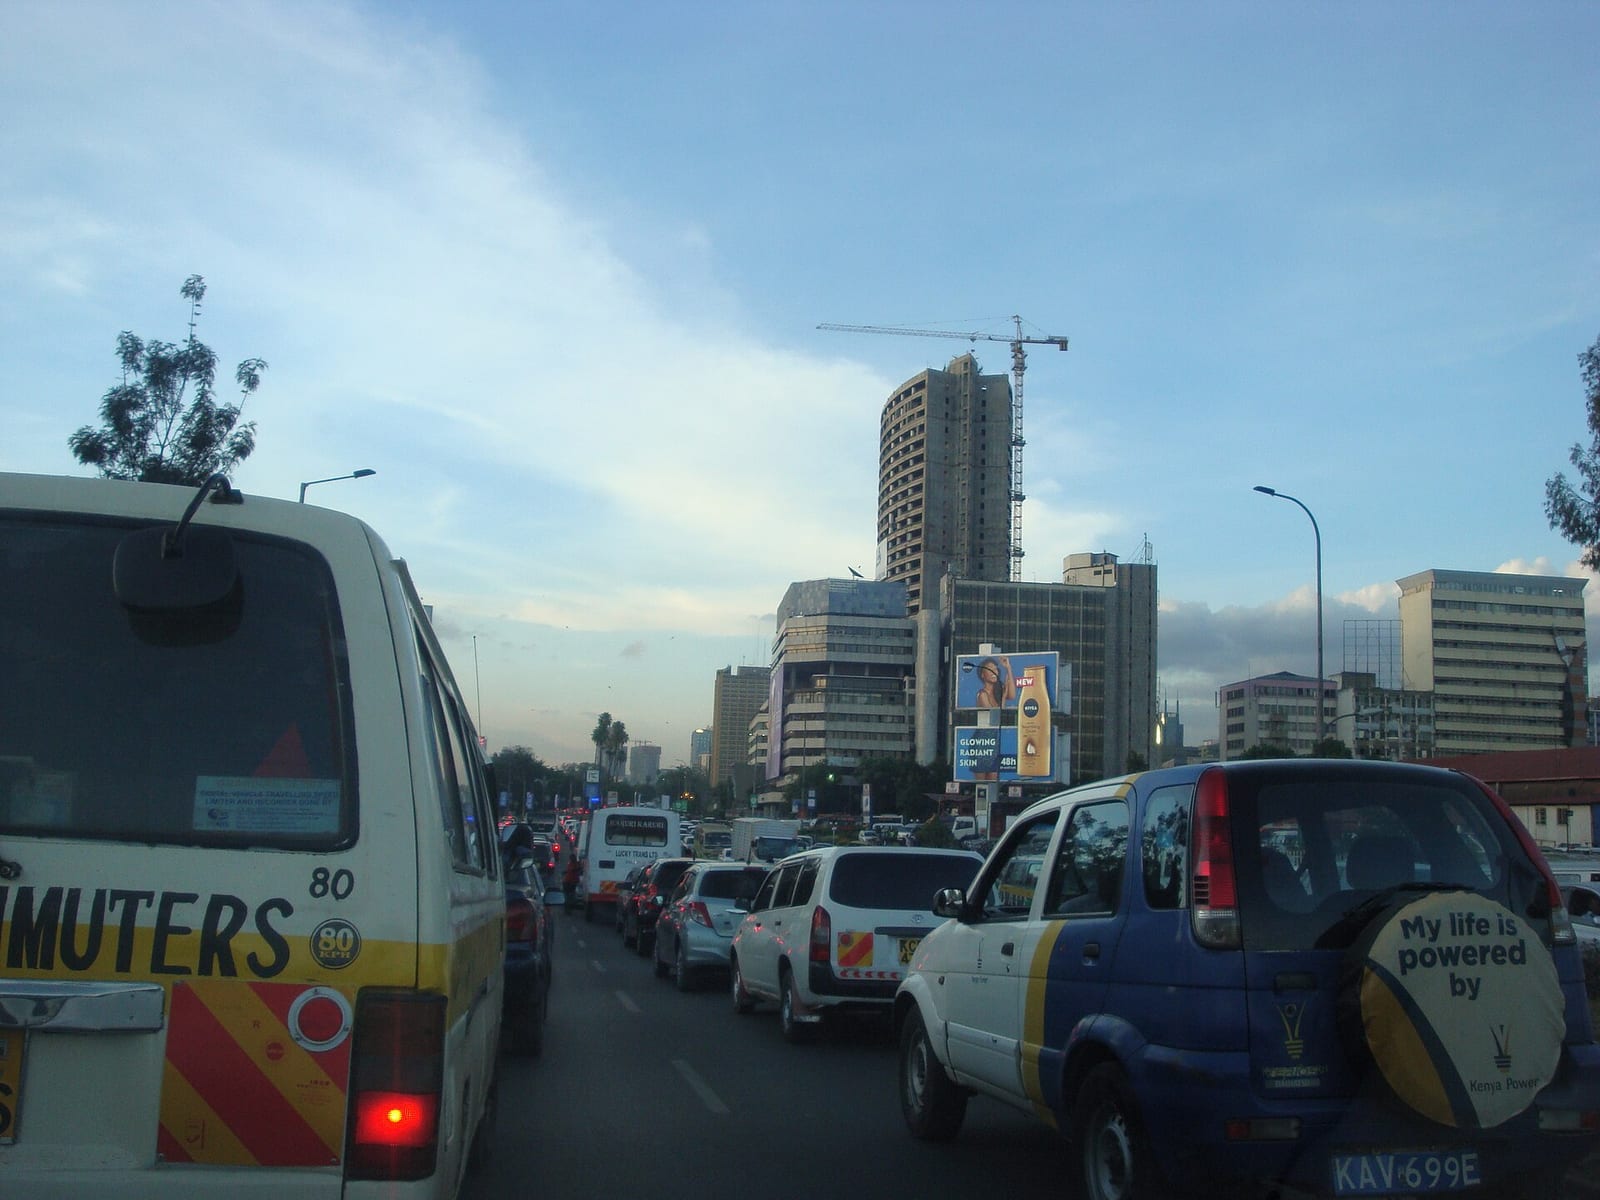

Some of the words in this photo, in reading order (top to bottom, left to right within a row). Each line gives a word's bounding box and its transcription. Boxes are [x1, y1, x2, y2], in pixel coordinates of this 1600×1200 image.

[1016, 678, 1033, 687] NEW
[960, 738, 996, 746] GLOWING
[960, 749, 994, 757] RADIANT
[1000, 757, 1017, 766] 48h
[960, 759, 978, 767] SKIN
[615, 850, 632, 858] LUCKY
[632, 850, 649, 858] TRANS
[309, 866, 355, 900] 80
[0, 886, 294, 978] MUTERS
[1400, 915, 1441, 943] My
[1449, 911, 1490, 936] life
[1496, 912, 1518, 936] is
[318, 927, 354, 952] 80
[900, 939, 921, 953] KC
[1398, 938, 1526, 976] powered
[1449, 972, 1481, 1001] by
[1469, 1079, 1502, 1096] Kenya
[1506, 1077, 1539, 1090] Power
[1335, 1155, 1395, 1191] KAV
[1406, 1152, 1481, 1188] 699E
